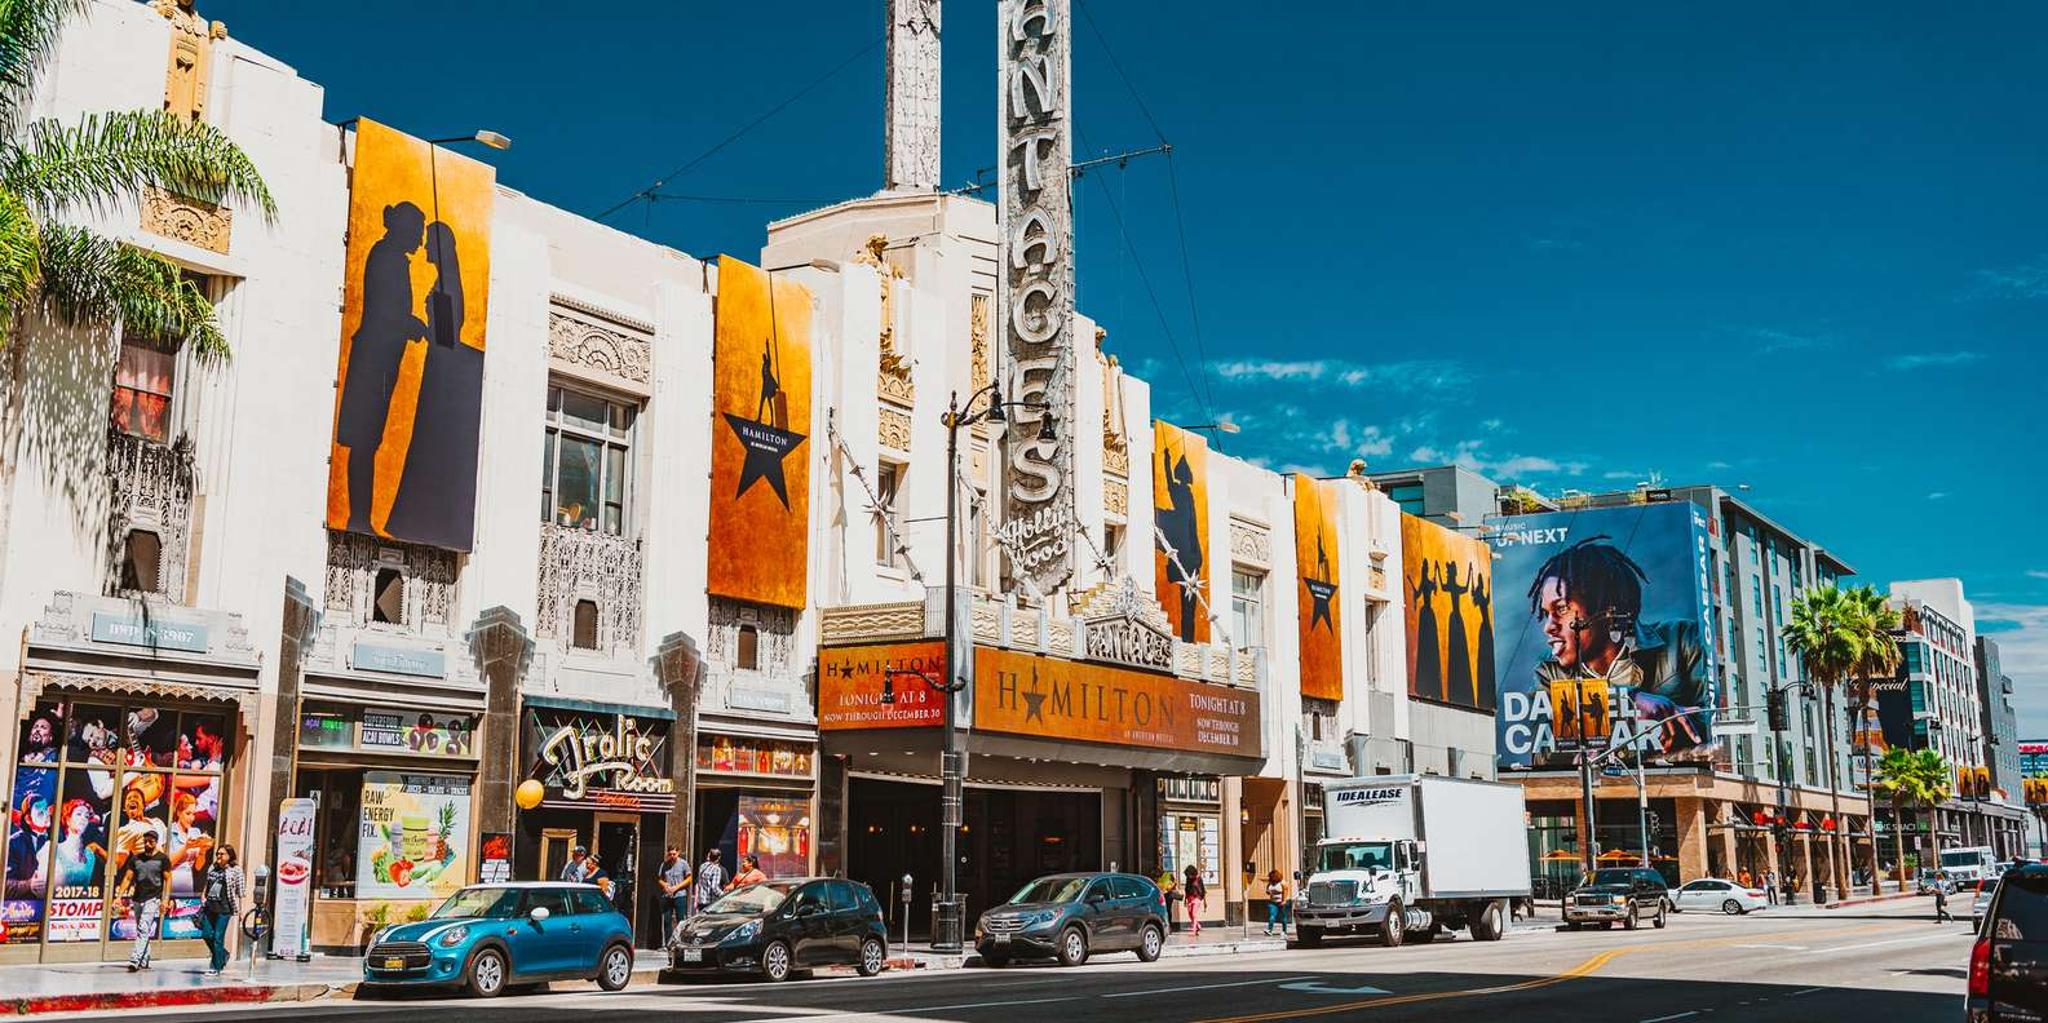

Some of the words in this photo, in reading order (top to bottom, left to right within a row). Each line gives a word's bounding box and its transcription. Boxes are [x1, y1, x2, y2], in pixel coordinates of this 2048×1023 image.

[742, 426, 788, 446] HAMILTON
[1521, 528, 1568, 545] NEXT
[1698, 535, 1712, 646] CAESAR
[1086, 624, 1172, 668] PANTAGES
[899, 690, 915, 704] AT
[919, 690, 926, 703] 8
[1189, 693, 1228, 714] TONIGHT
[1228, 699, 1239, 715] AT
[1240, 701, 1246, 716] 8
[824, 711, 842, 723] NOW
[845, 710, 886, 722] THROUGH
[887, 709, 930, 720] DECEMBER
[931, 708, 941, 718] 30
[1197, 718, 1211, 731] NOW
[1212, 719, 1240, 733] THROUGH
[1198, 730, 1231, 745] DECEMBER
[1504, 718, 1666, 755] CAAR
[542, 714, 652, 799] Frolic
[602, 762, 674, 793] Room
[1157, 778, 1219, 797] DINING
[1336, 788, 1403, 801] IDEALEASE
[364, 790, 384, 805] RAW
[363, 806, 395, 822] ENERGY
[55, 886, 99, 898] 2017-18
[50, 902, 103, 917] STOMP
